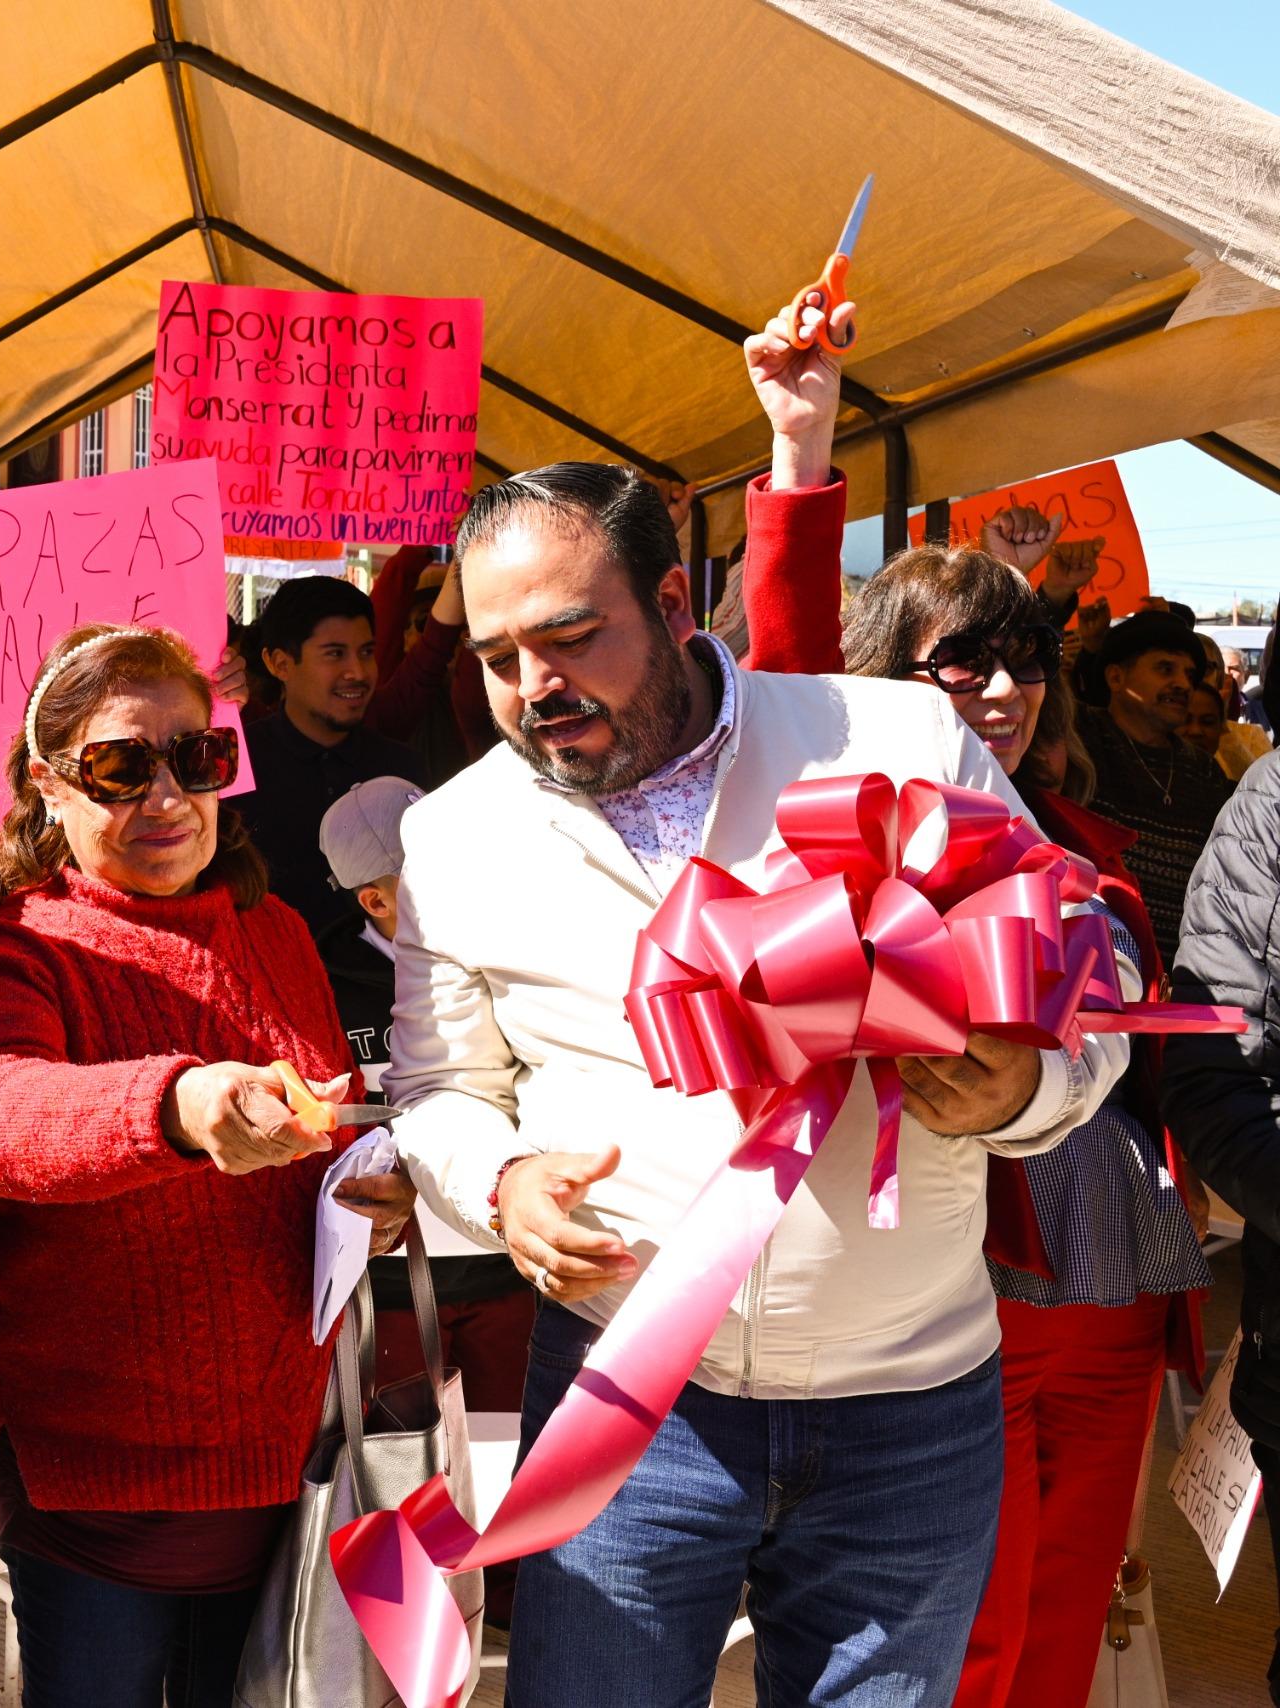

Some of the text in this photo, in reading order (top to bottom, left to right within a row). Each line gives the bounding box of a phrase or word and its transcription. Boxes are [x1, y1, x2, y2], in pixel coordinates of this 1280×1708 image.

[159, 282, 456, 362] Apoyamos a
[162, 333, 407, 390] la Presidenta
[152, 375, 478, 449] Monserrat y pedimos
[227, 469, 283, 508] calle
[331, 512, 357, 542] un
[363, 512, 413, 542] buen
